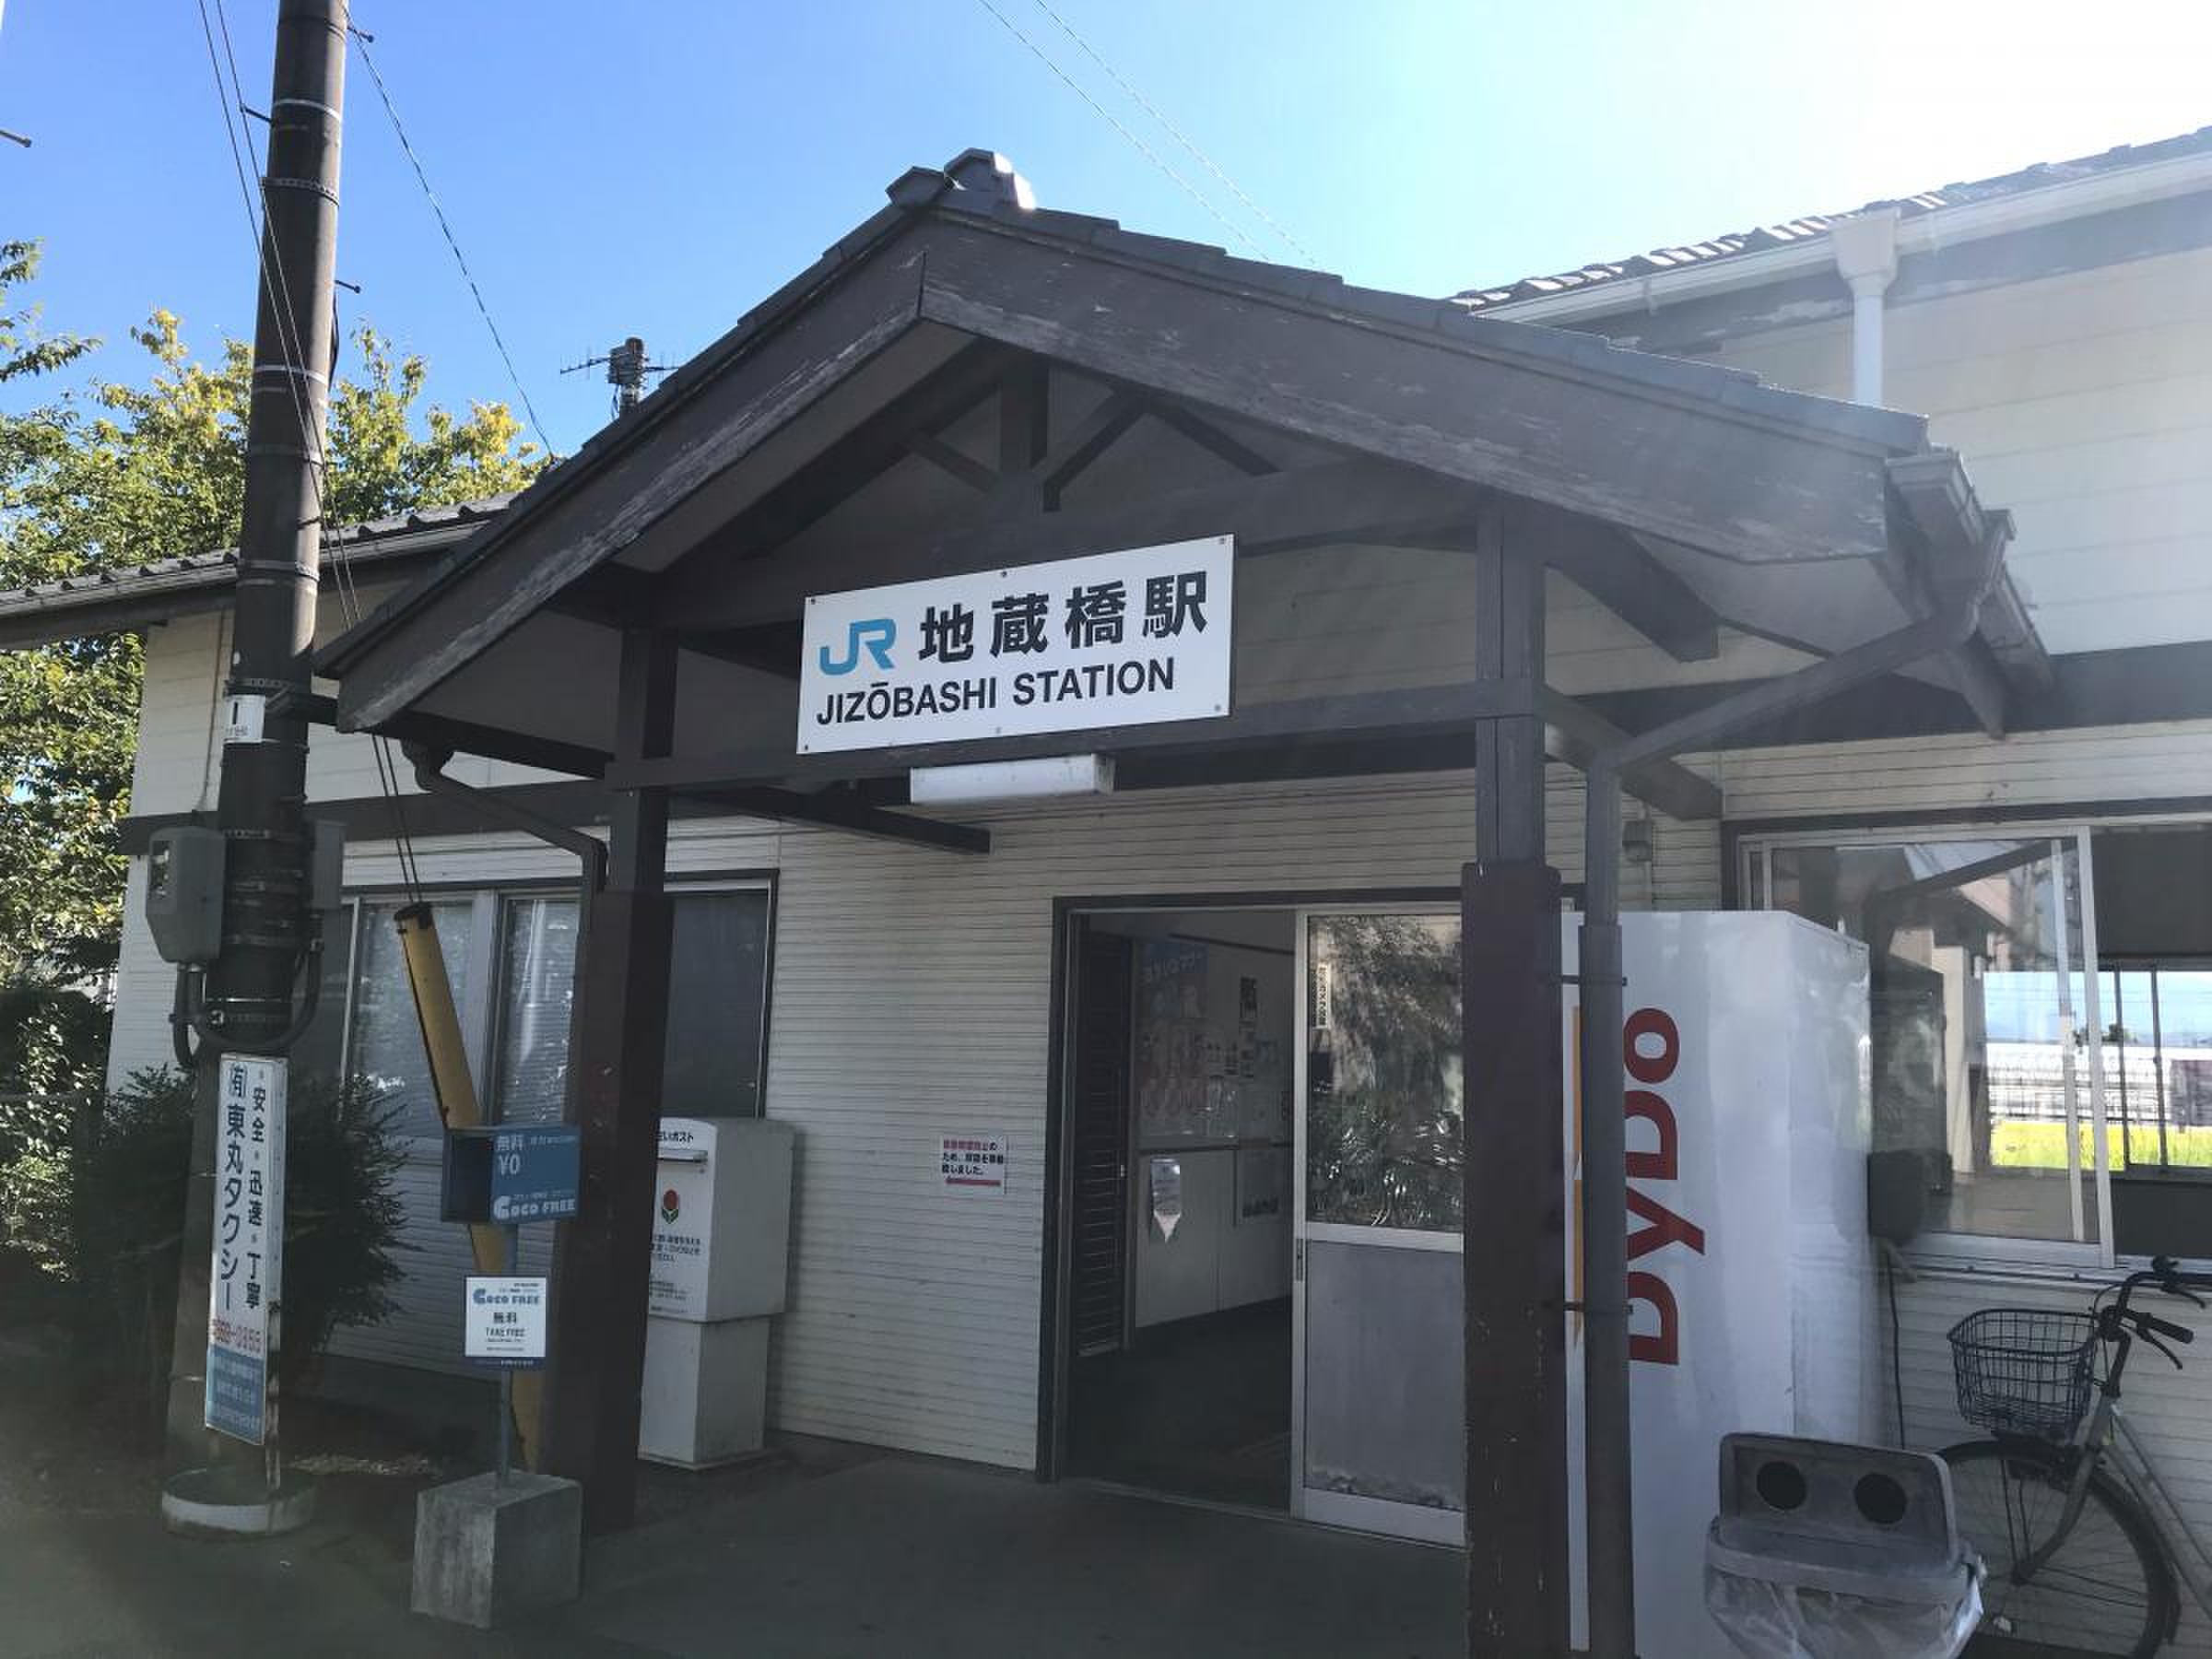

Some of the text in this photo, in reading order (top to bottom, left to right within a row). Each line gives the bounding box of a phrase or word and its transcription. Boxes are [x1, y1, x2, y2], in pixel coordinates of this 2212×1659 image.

[819, 618, 897, 676] JR
[918, 571, 1208, 663] 地蔵橋駅
[817, 657, 1174, 724] JIZŌBASHI STATION
